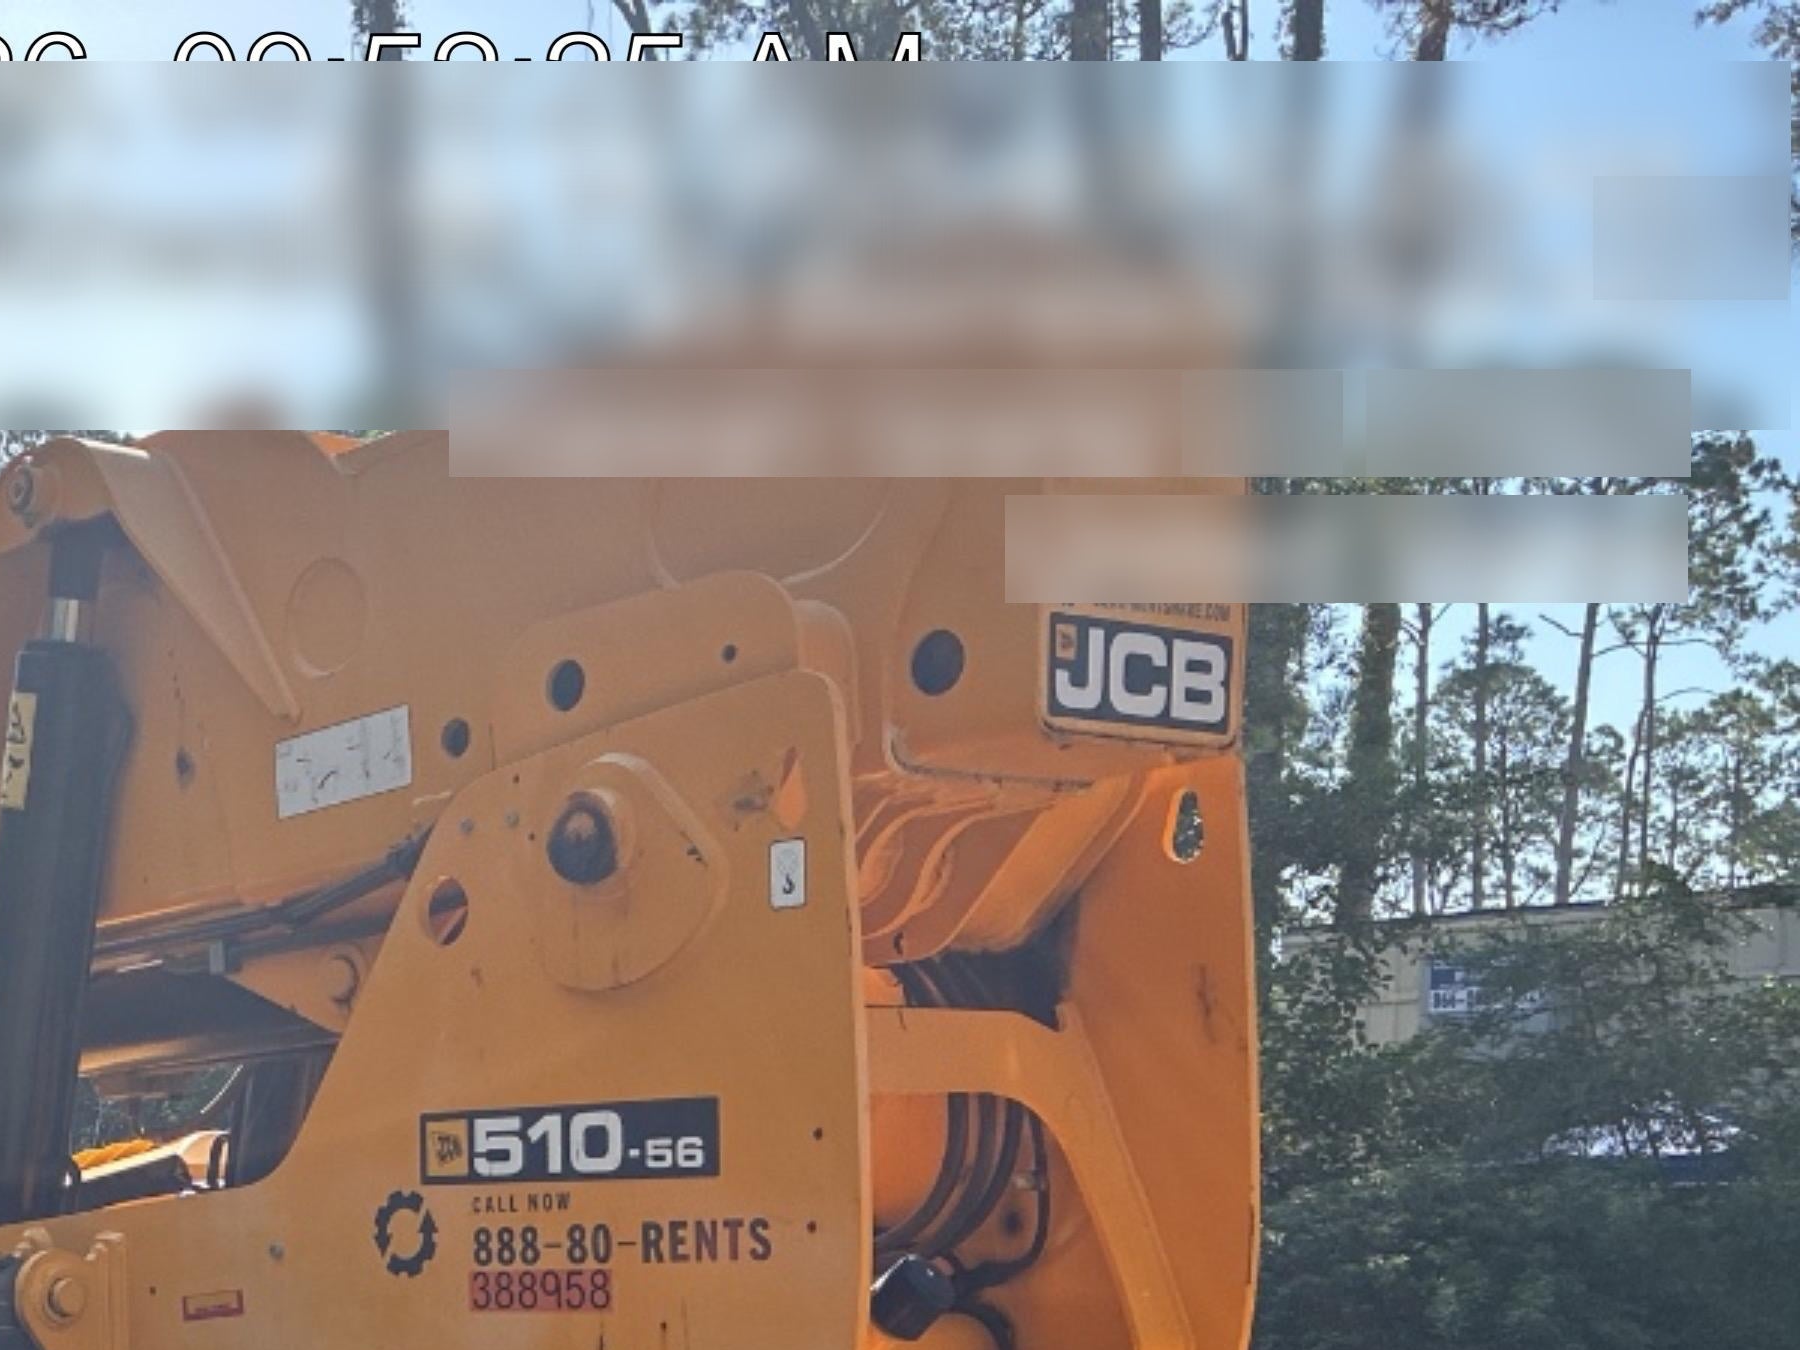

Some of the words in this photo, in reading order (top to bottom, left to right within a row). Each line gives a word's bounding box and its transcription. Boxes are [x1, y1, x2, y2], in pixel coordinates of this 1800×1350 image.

[1055, 626, 1227, 723] JCB
[472, 1109, 705, 1177] 510-56
[471, 1196, 518, 1214] CALL
[527, 1192, 571, 1212] NOW
[473, 1217, 773, 1267] 888-80-RENTS
[472, 1268, 611, 1310] 388958
